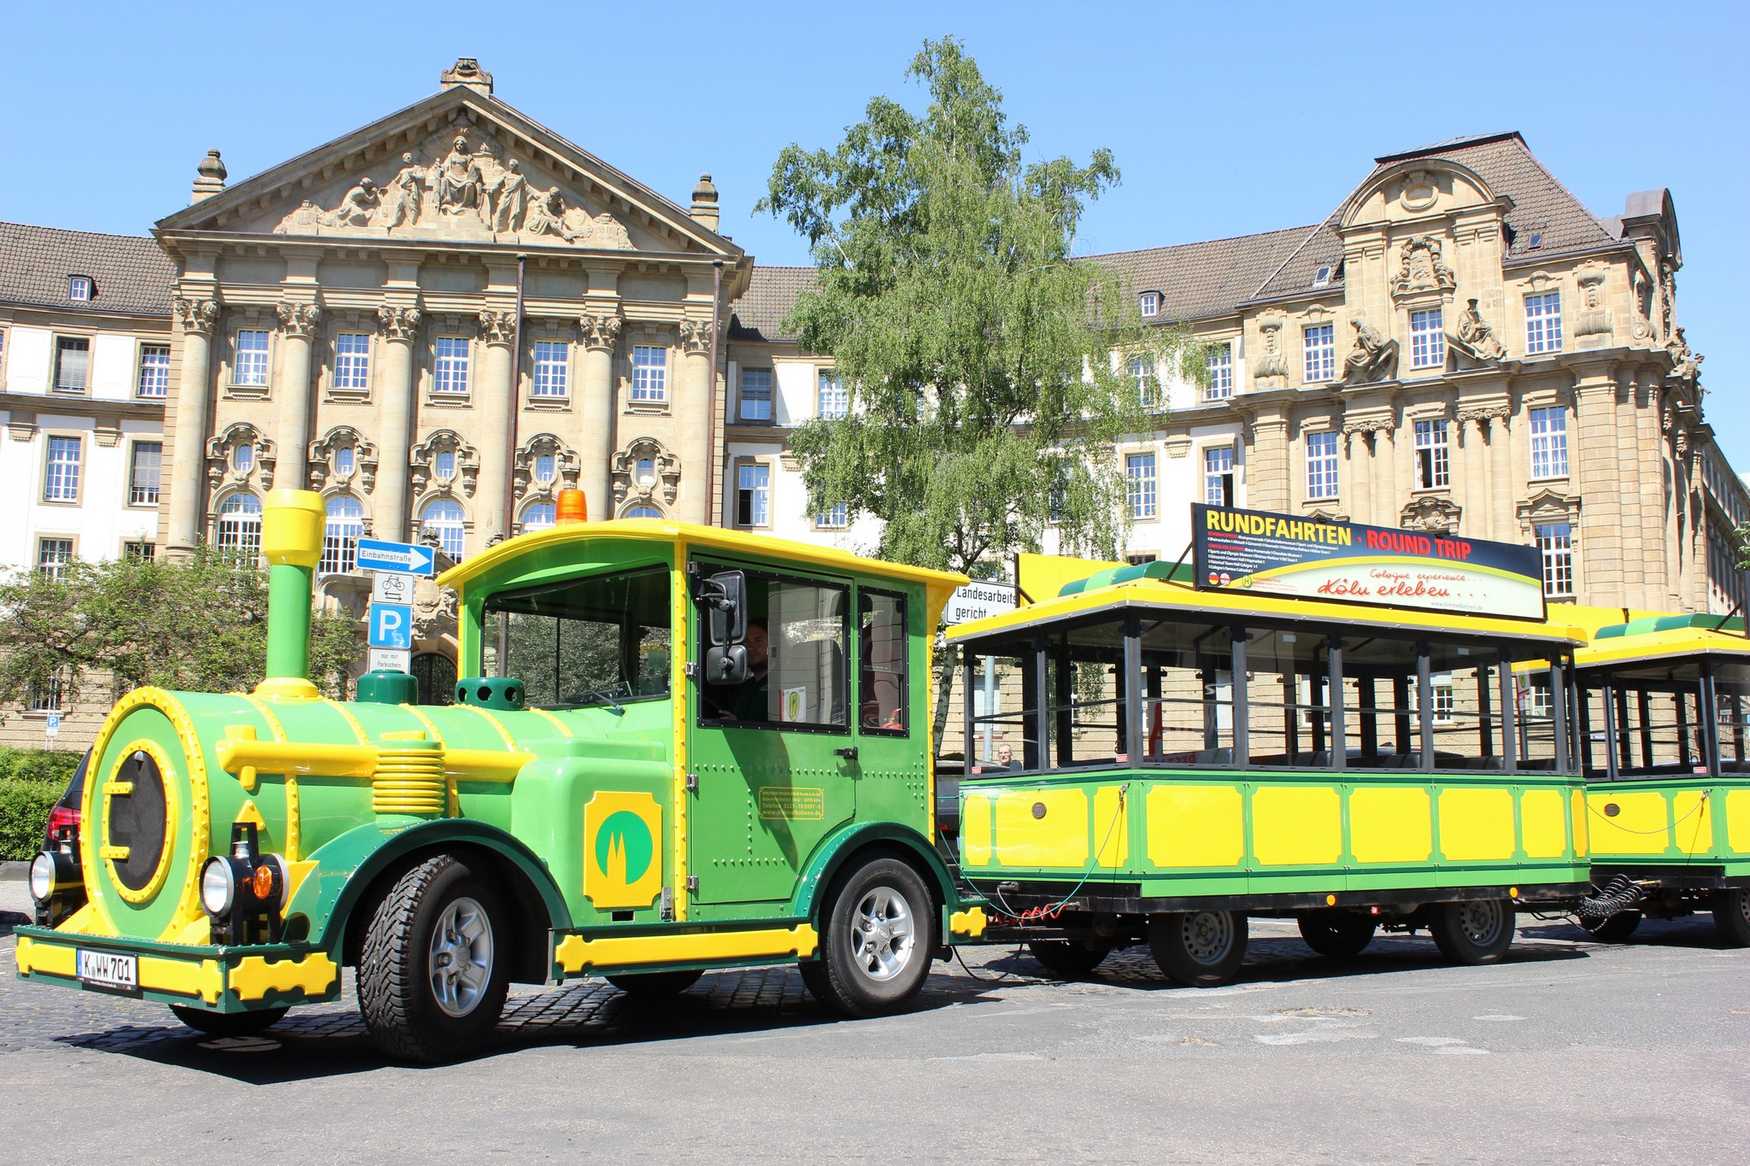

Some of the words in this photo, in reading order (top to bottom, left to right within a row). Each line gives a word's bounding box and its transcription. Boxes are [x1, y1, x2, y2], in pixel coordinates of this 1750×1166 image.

[1206, 510, 1352, 546] RUNDFAHRTEN
[1366, 529, 1431, 555] ROUND
[1435, 538, 1472, 560] TRIP
[361, 549, 412, 562] Einbahnstraße
[379, 610, 402, 641] P
[956, 607, 986, 620] gericht
[111, 957, 131, 982] 701
